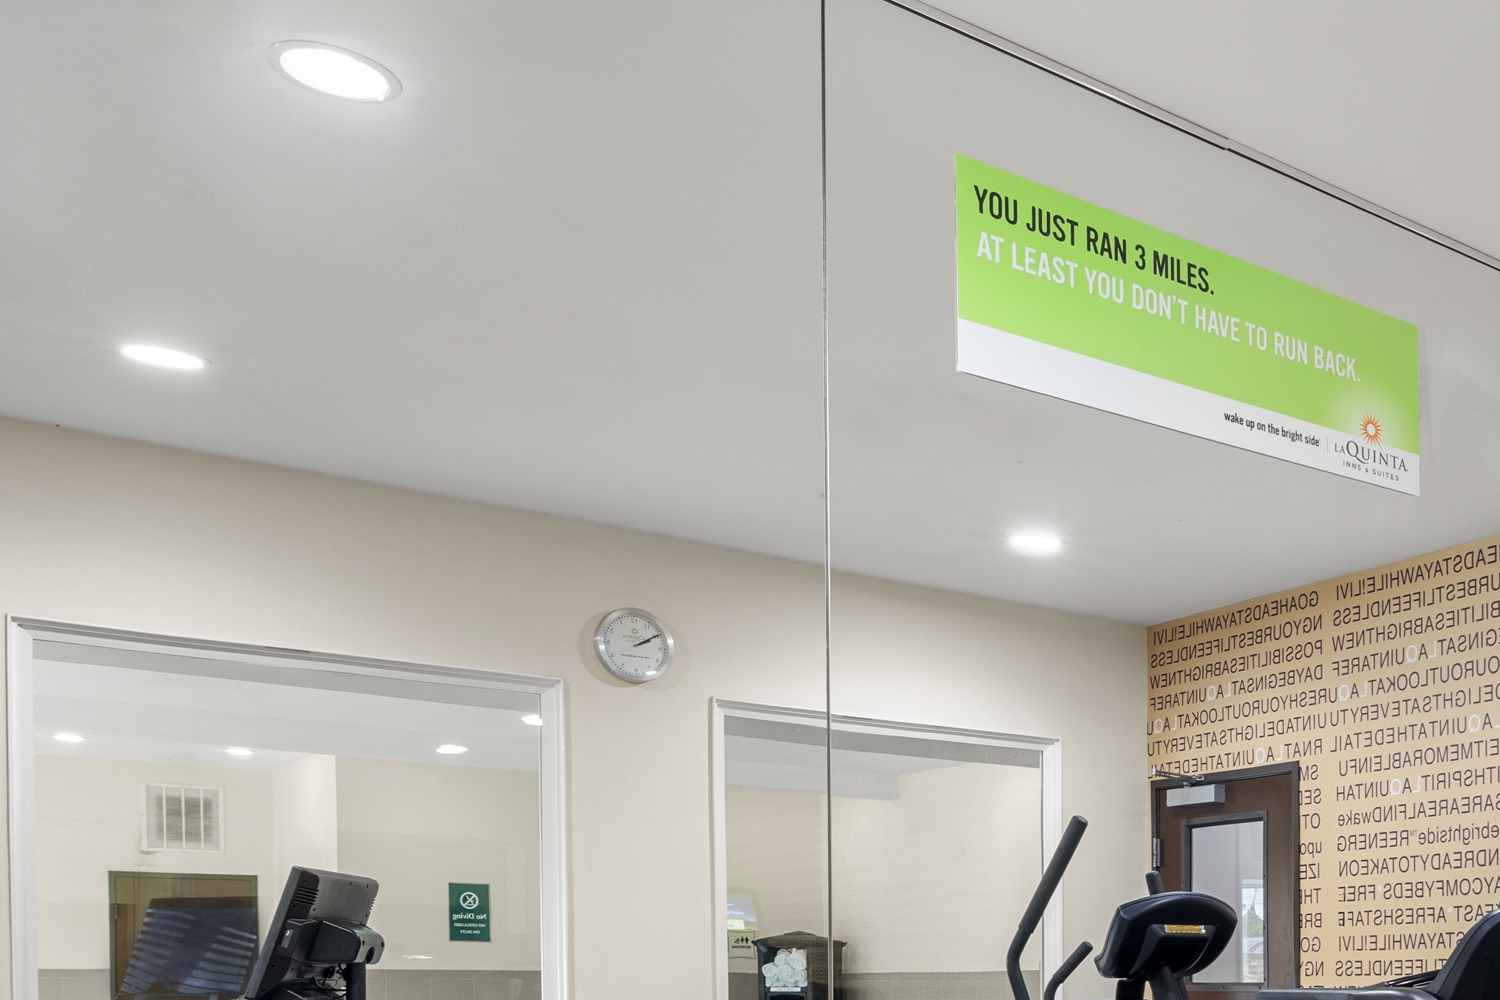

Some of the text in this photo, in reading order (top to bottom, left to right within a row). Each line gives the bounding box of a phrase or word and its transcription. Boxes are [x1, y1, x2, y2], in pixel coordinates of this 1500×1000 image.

[974, 184, 1215, 297] YOU JUST RAN 3 MILES.
[976, 231, 1004, 265] AT
[1011, 241, 1079, 290] LEAST
[1084, 266, 1126, 304] YOU
[1194, 305, 1241, 344] HAVE
[1246, 322, 1268, 351] TO
[1273, 331, 1308, 367] RUN
[1314, 343, 1362, 383] BACK.
[1223, 411, 1244, 427] wake
[1245, 419, 1256, 432] up
[1257, 420, 1266, 432] on
[1267, 421, 1280, 435] the
[1281, 425, 1303, 444] bright
[1342, 459, 1400, 482] INNS & SUITES
